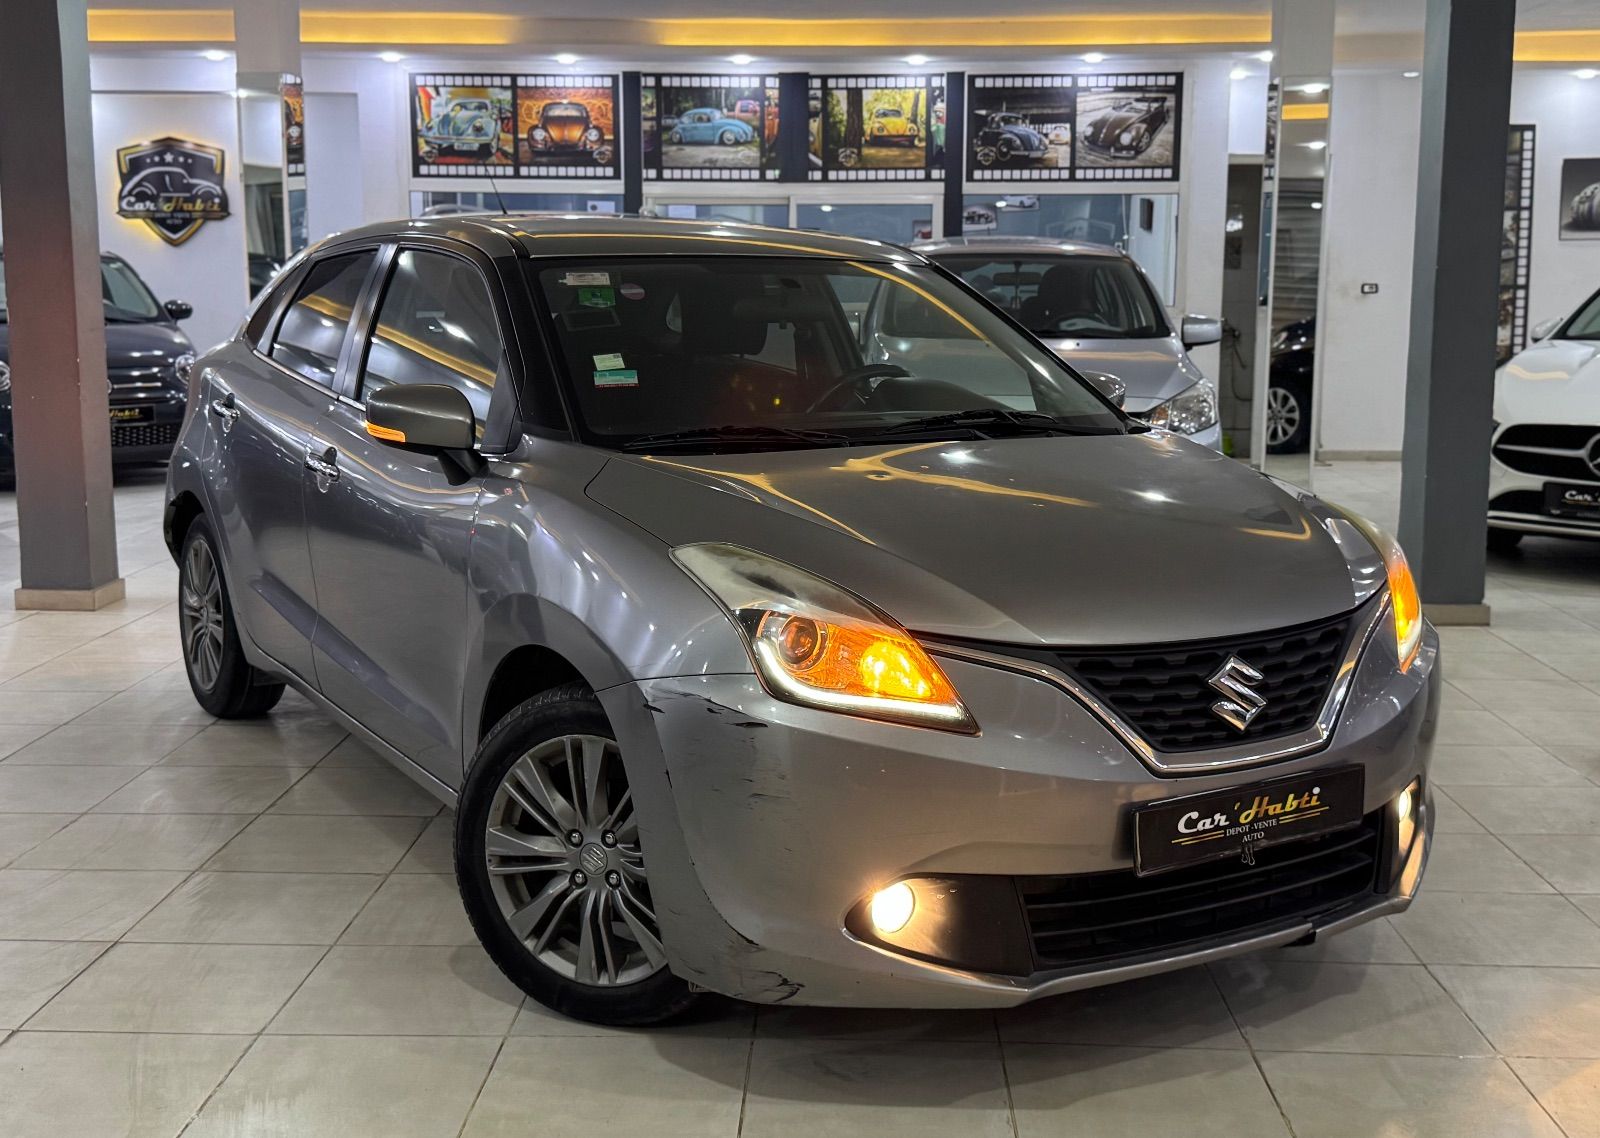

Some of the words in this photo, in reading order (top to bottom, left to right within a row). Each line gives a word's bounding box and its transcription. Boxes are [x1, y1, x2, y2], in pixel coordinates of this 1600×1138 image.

[121, 196, 157, 211] Car
[1177, 811, 1229, 834] Car
[1242, 831, 1265, 843] AUTO
